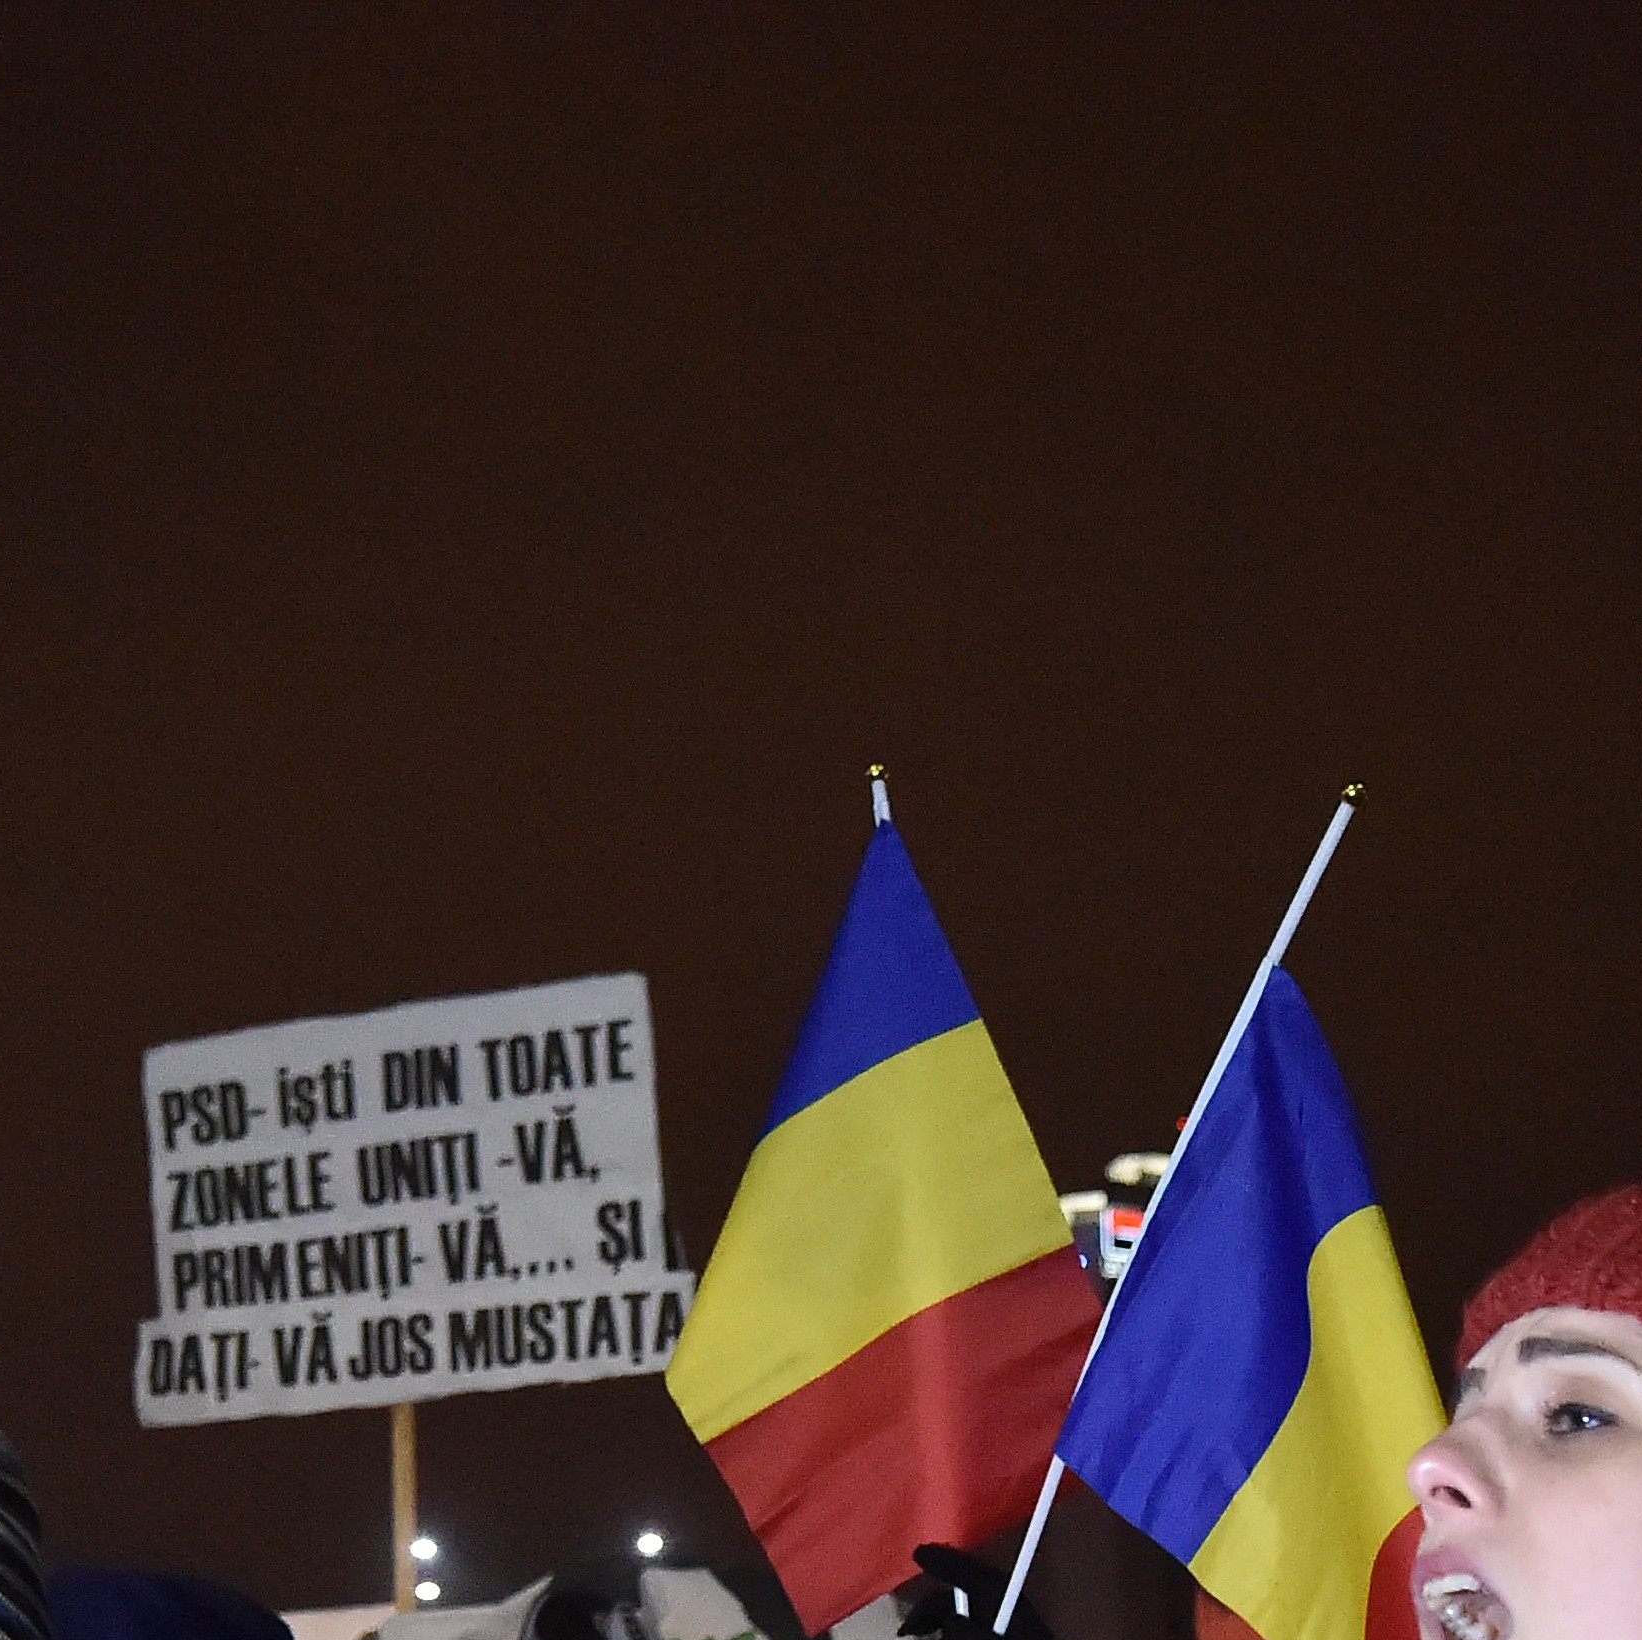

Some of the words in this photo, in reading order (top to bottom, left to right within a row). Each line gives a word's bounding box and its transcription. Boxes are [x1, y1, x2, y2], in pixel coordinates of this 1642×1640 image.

[382, 1044, 463, 1113] DIN
[479, 1019, 635, 1103] TOATE
[167, 1151, 338, 1233] ZONELE
[348, 1312, 434, 1381] JOS
